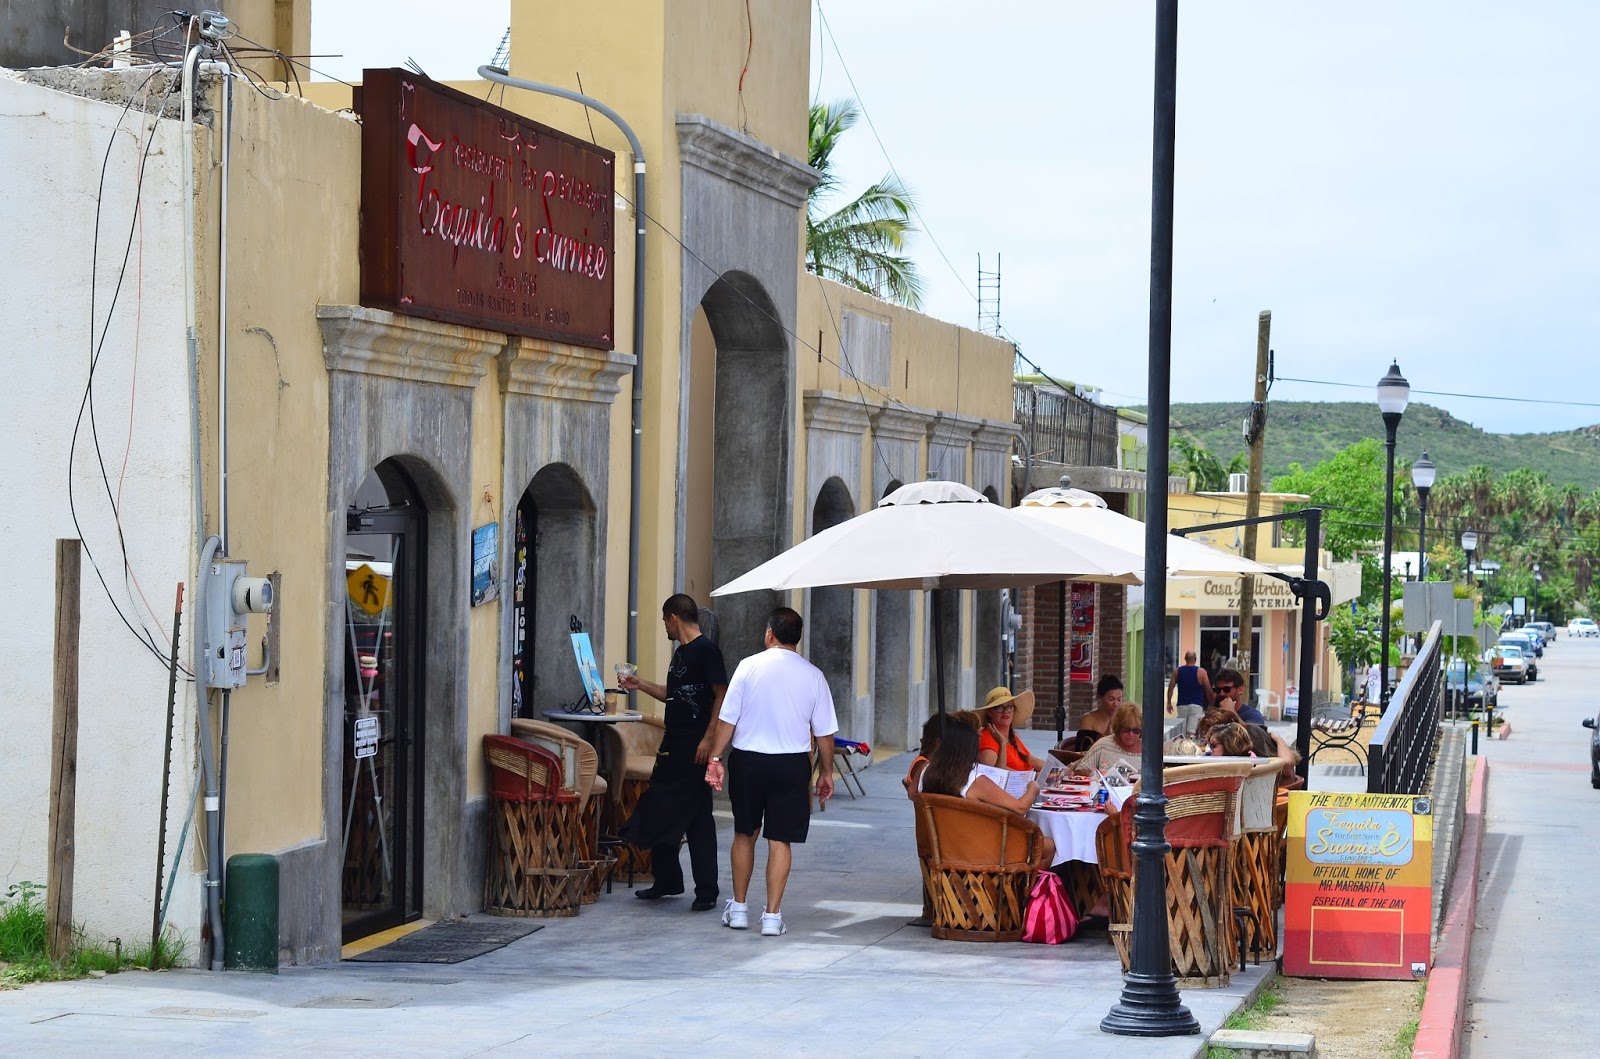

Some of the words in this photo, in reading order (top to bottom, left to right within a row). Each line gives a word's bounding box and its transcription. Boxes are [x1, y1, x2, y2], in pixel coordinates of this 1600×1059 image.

[521, 159, 537, 190] Bar
[535, 171, 608, 280] Sunrise
[457, 289, 484, 309] TODOS
[1204, 580, 1233, 597] Casa
[1234, 576, 1285, 597] ltrán
[1228, 598, 1294, 608] ZAATERIA
[1309, 794, 1331, 807] THE
[1332, 795, 1353, 808] OLD
[1359, 795, 1412, 809] AUTHENTIC
[1309, 828, 1410, 857] Sunrise
[1313, 866, 1350, 879] OFFICIAL
[1354, 867, 1382, 880] HOME
[1385, 868, 1400, 880] OF
[1318, 879, 1333, 892] MR.
[1334, 880, 1385, 893] MARGARITA
[1312, 896, 1355, 907] ESPECIAL
[1357, 898, 1369, 908] OF
[1370, 898, 1389, 908] THE
[1389, 899, 1406, 909] DAY
